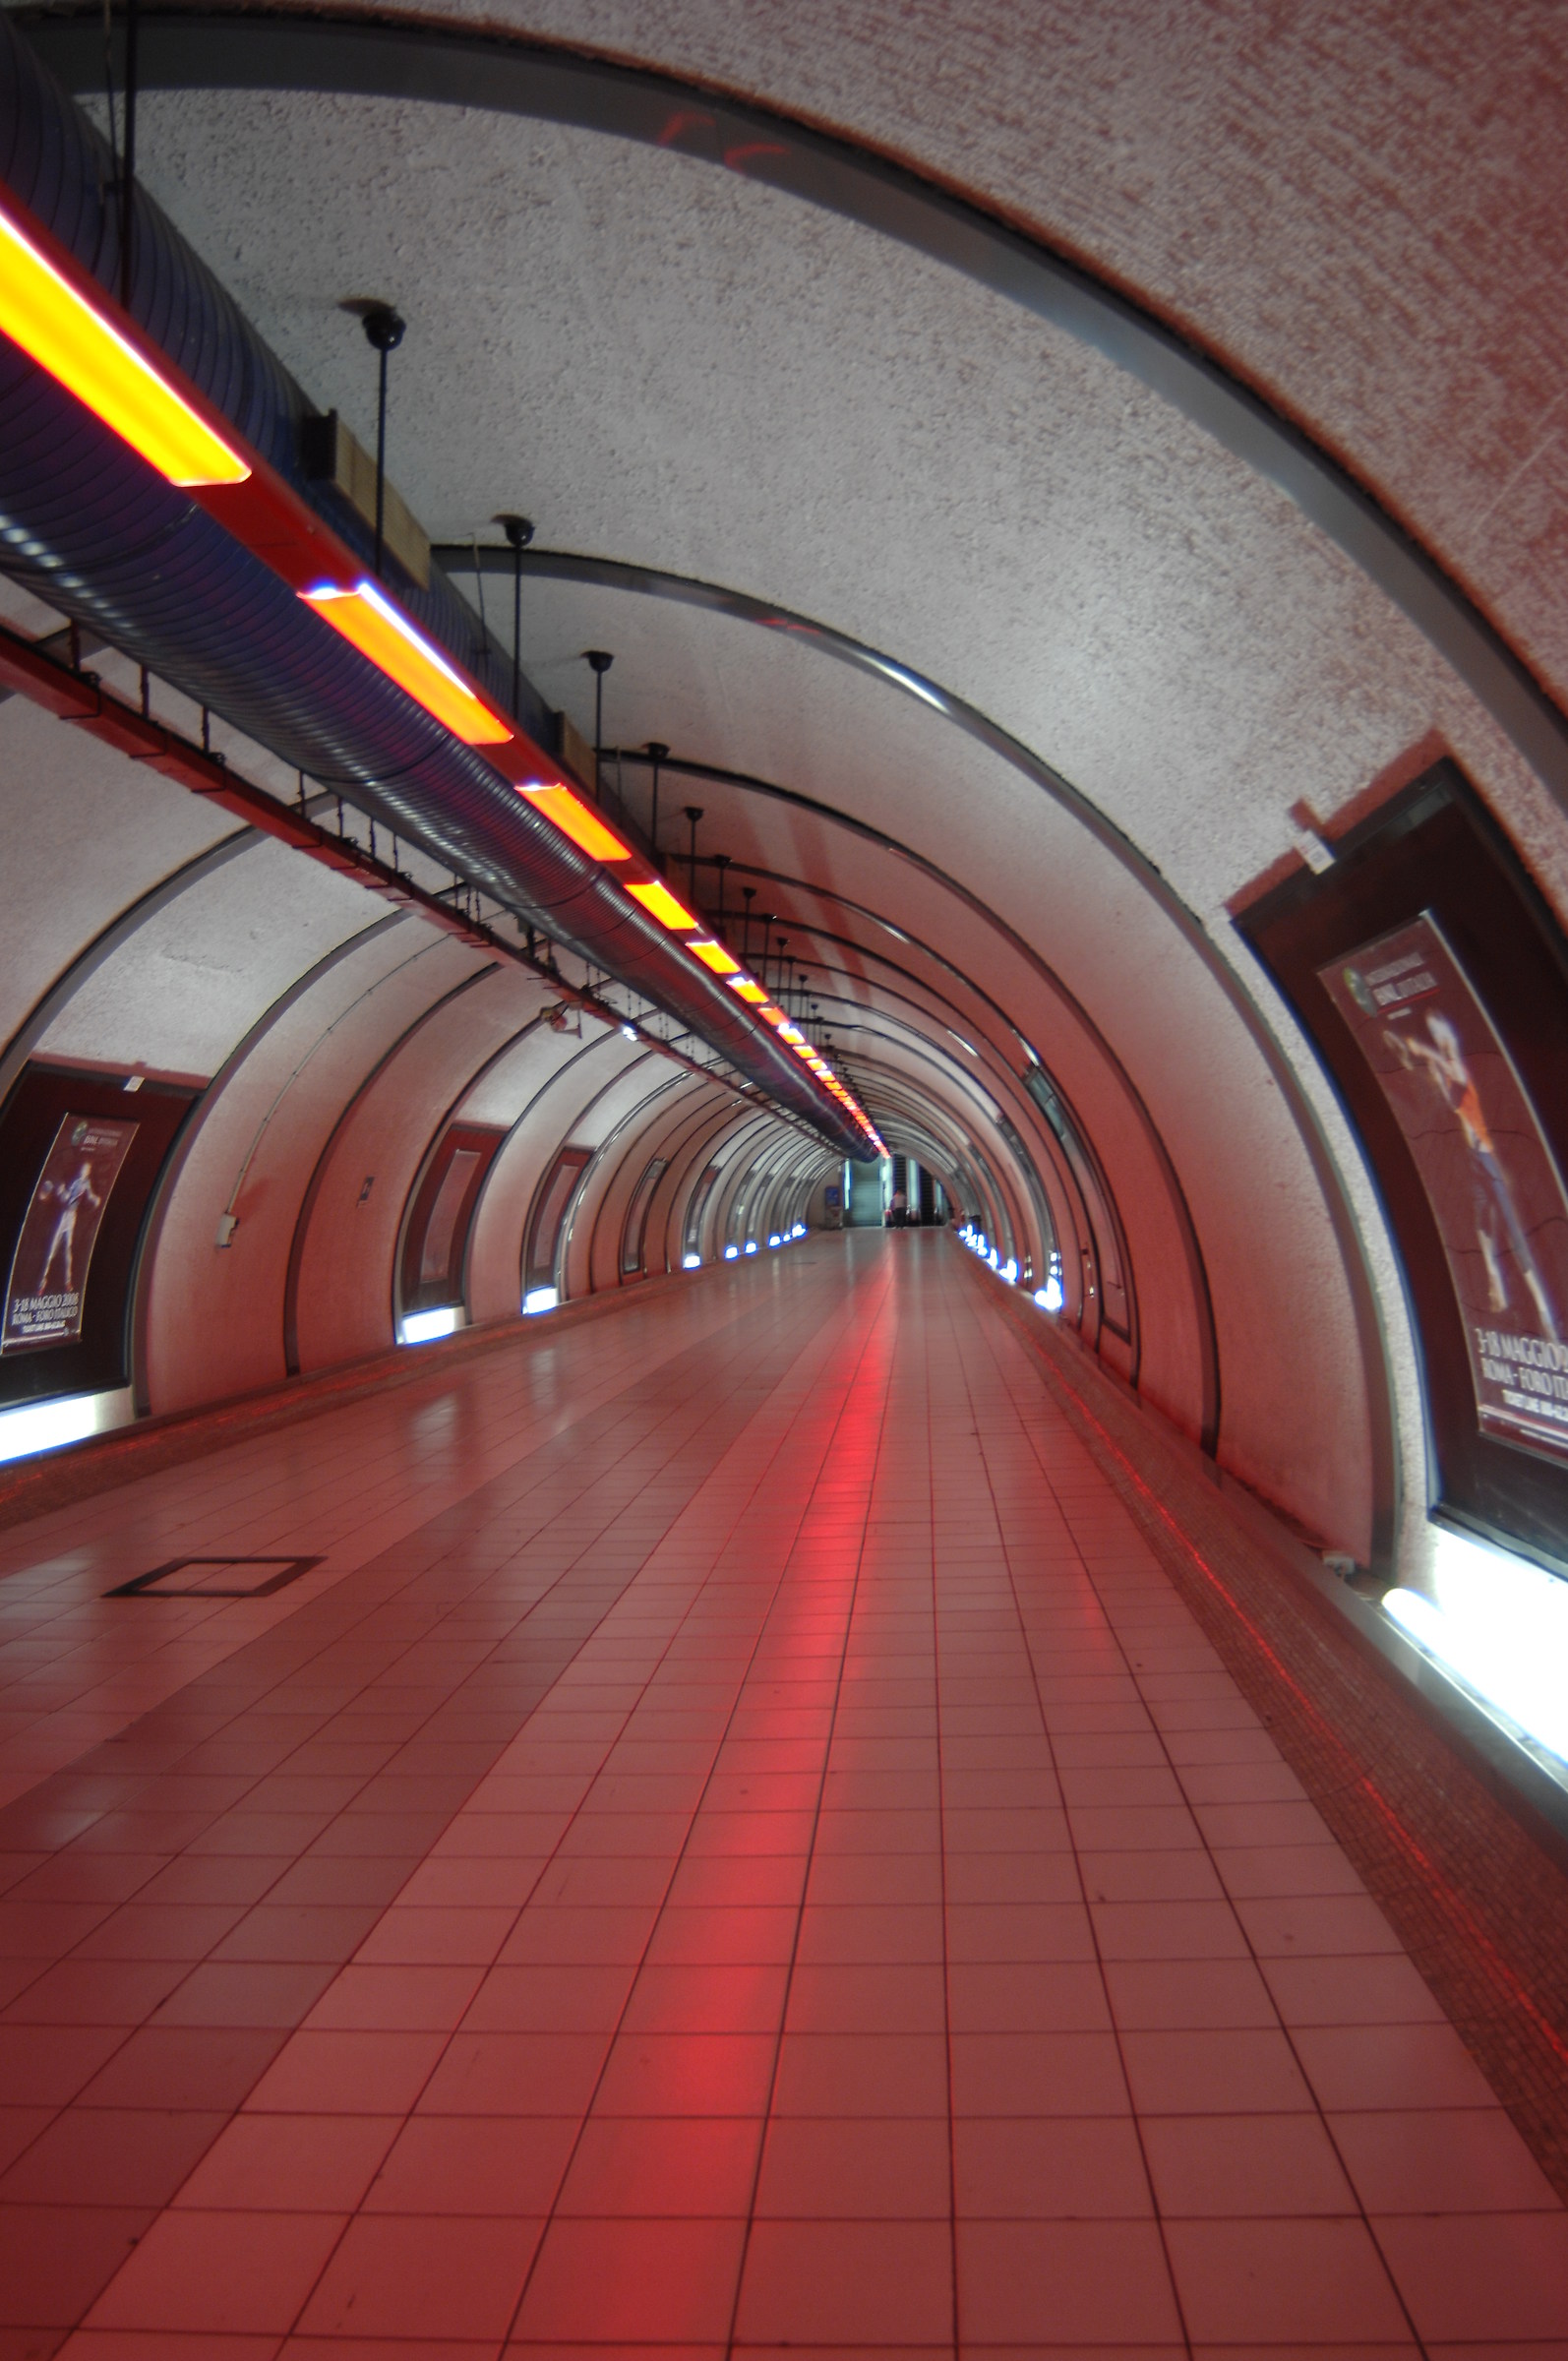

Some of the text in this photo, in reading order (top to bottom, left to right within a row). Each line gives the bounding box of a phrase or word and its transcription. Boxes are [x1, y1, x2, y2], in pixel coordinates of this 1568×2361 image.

[30, 1295, 63, 1310] MAGGIO
[12, 1312, 32, 1326] ROMA
[35, 1309, 55, 1322] FORO
[1500, 1333, 1560, 1371] MAGGIO
[1480, 1358, 1515, 1386] ROMA
[1518, 1365, 1553, 1397] FORO
